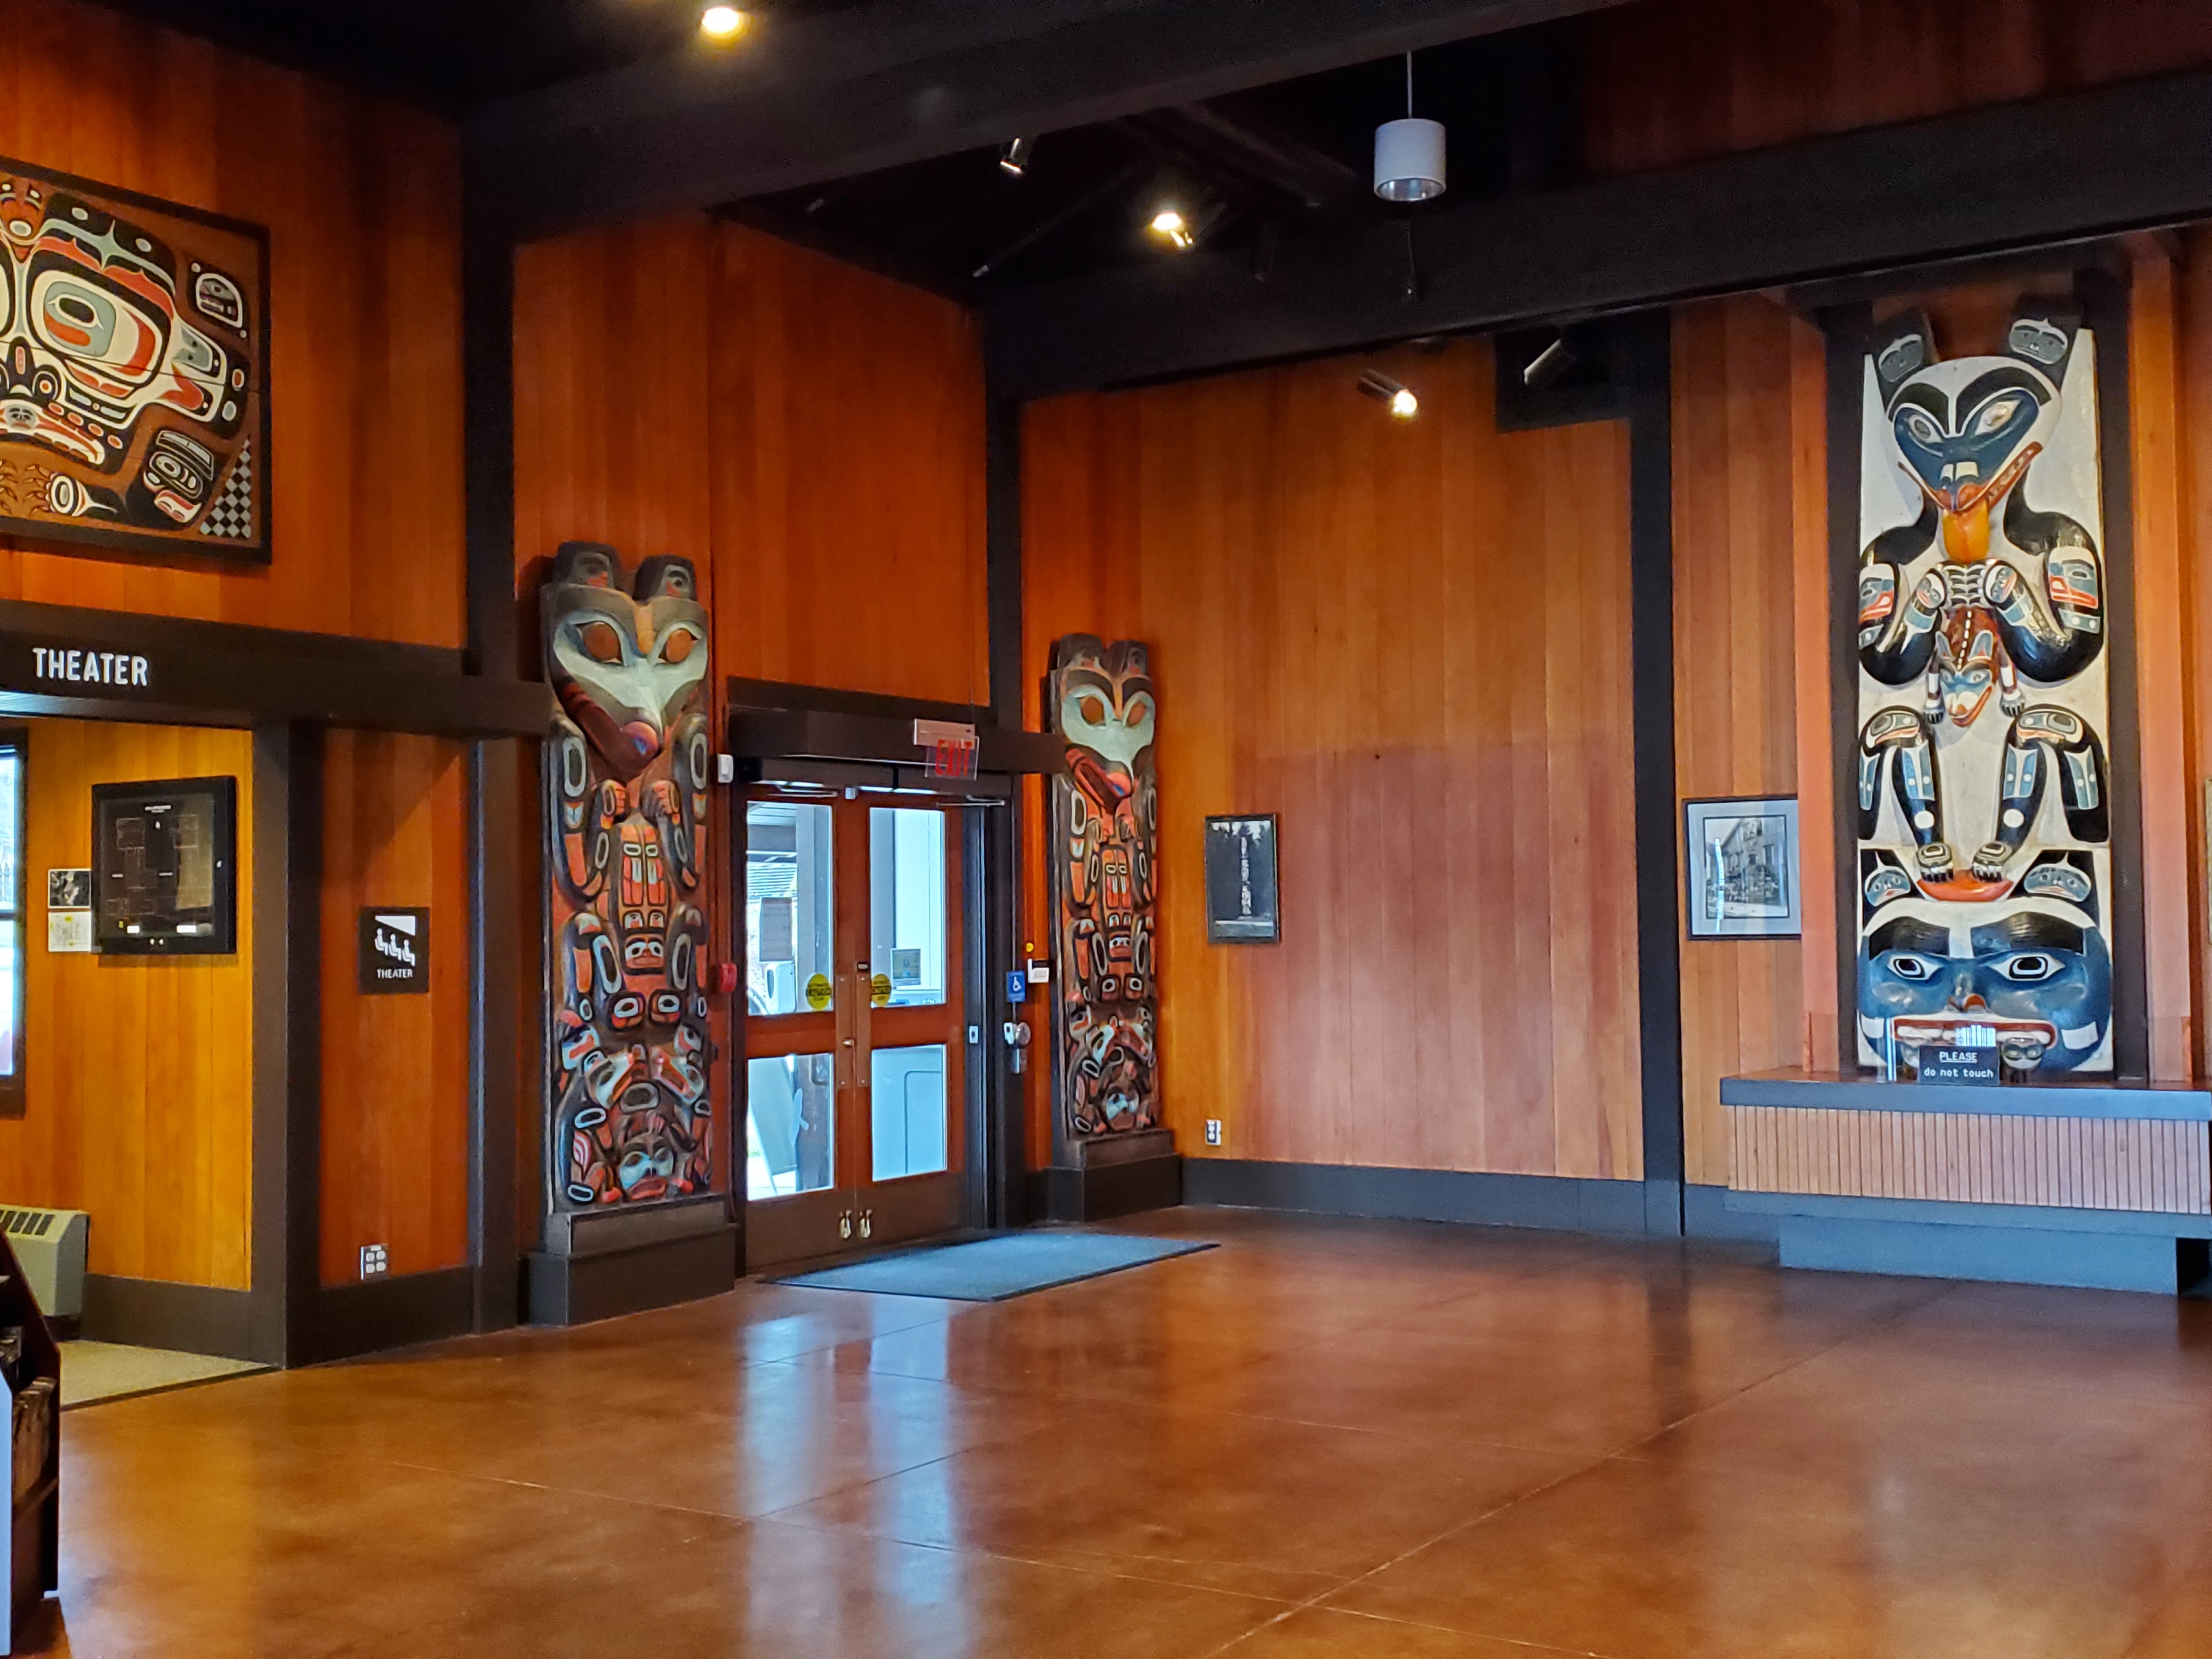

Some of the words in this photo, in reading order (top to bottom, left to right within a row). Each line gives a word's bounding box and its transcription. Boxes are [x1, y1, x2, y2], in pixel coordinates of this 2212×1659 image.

[32, 647, 148, 686] THEATER
[935, 739, 972, 777] EXIT
[376, 968, 413, 979] THEATER
[1939, 1051, 1978, 1061] PLEASE
[1924, 1067, 1936, 1076] do
[1940, 1068, 1959, 1077] not
[1962, 1068, 1994, 1078] touch
